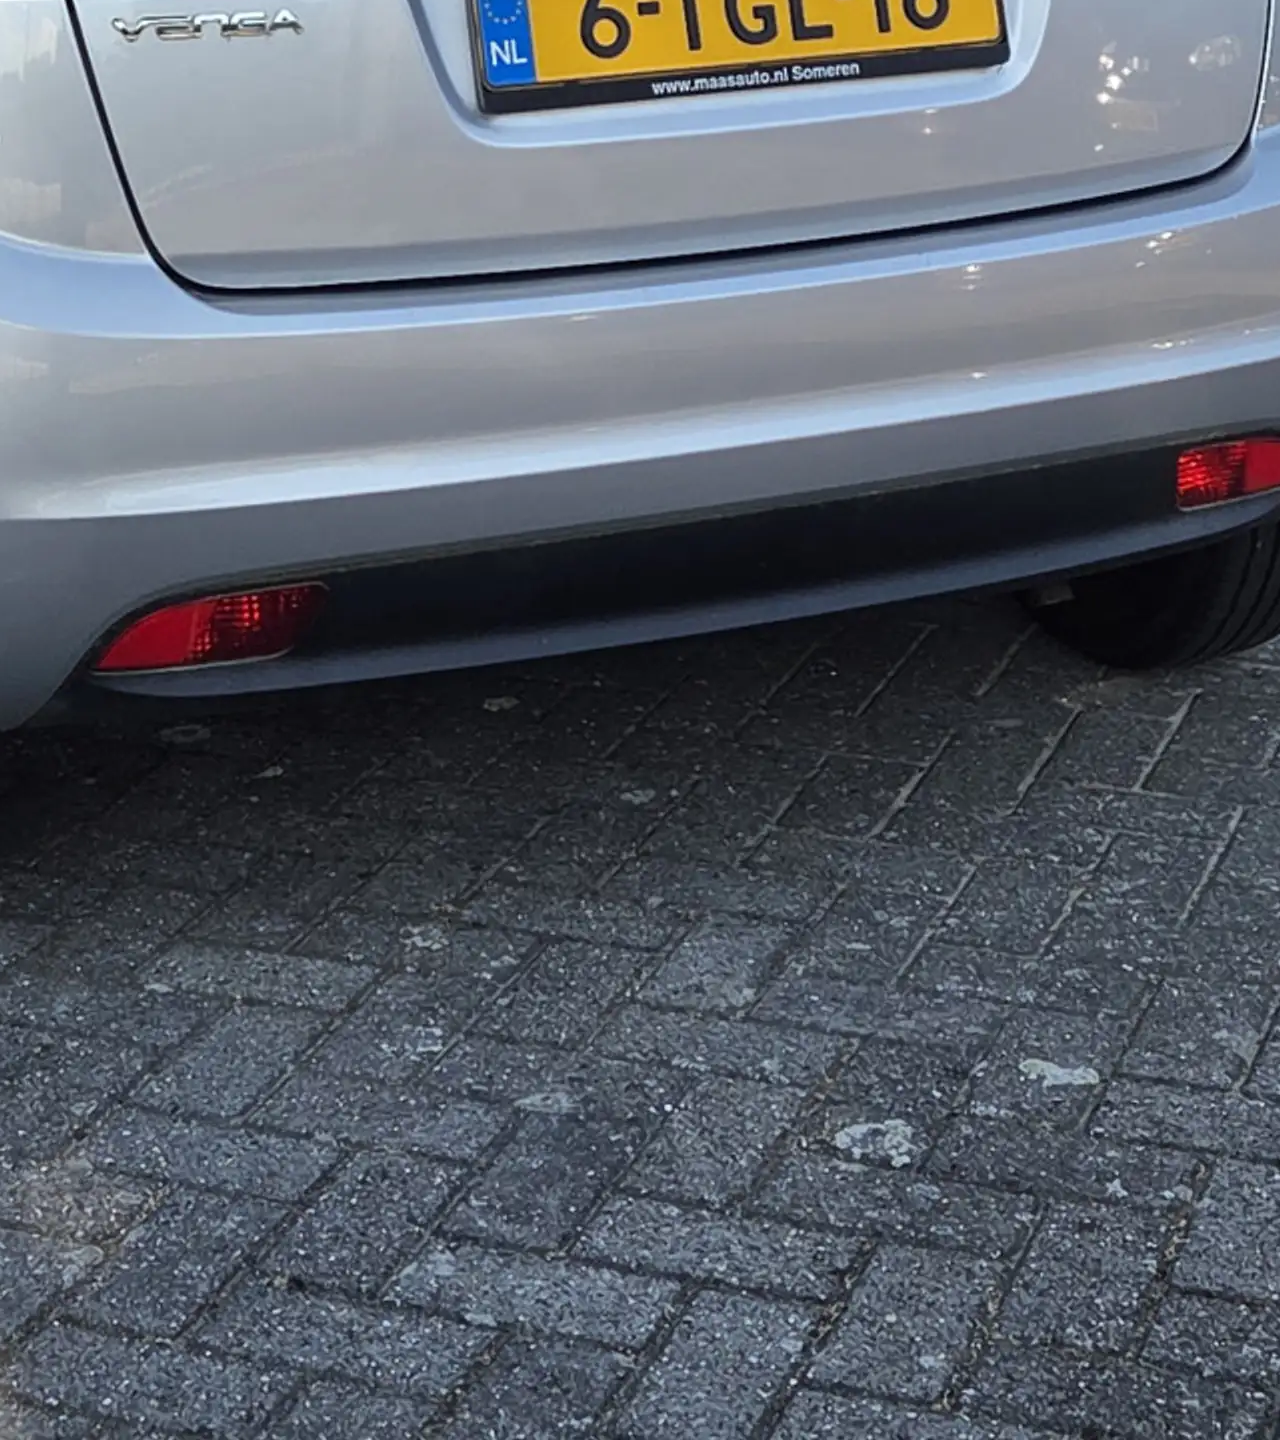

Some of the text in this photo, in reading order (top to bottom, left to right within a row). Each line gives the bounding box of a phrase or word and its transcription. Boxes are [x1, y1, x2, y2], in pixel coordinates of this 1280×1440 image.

[489, 40, 528, 67] NL
[651, 62, 861, 96] www.maasauto.nl Someren
